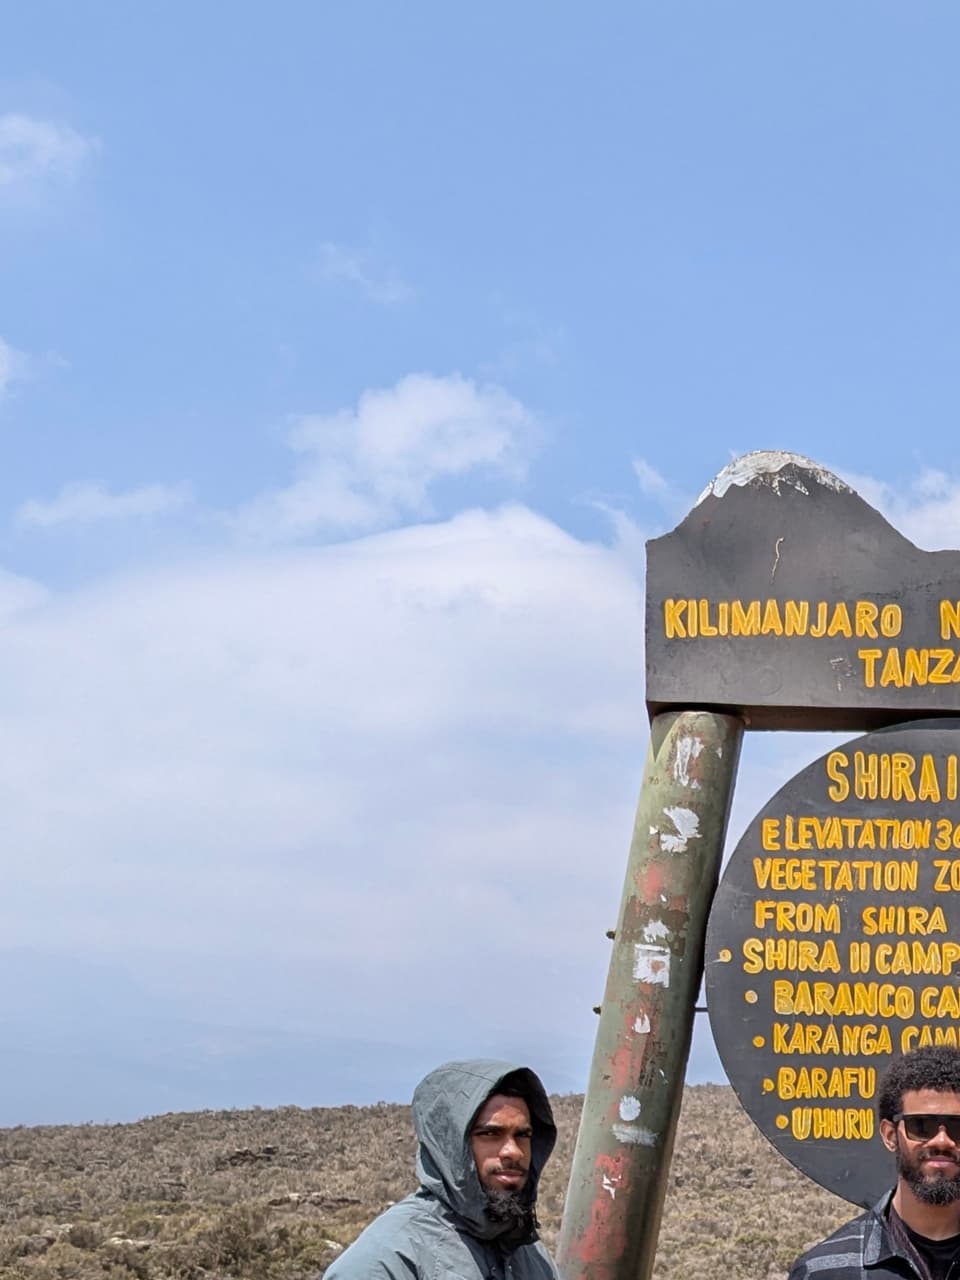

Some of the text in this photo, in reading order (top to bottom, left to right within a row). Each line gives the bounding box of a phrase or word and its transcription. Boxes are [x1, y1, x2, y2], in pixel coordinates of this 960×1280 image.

[664, 598, 903, 640] KILIMANJARO
[752, 857, 919, 892] VEGETATION
[754, 899, 841, 935] FROM
[862, 904, 949, 937] SHIRA
[742, 937, 842, 976] SHIRA
[849, 940, 872, 976] II
[772, 978, 916, 1020] BARANCO
[772, 1021, 894, 1057] KARANGA
[777, 1066, 877, 1101] BARAFU
[791, 1105, 876, 1141] UHURU
